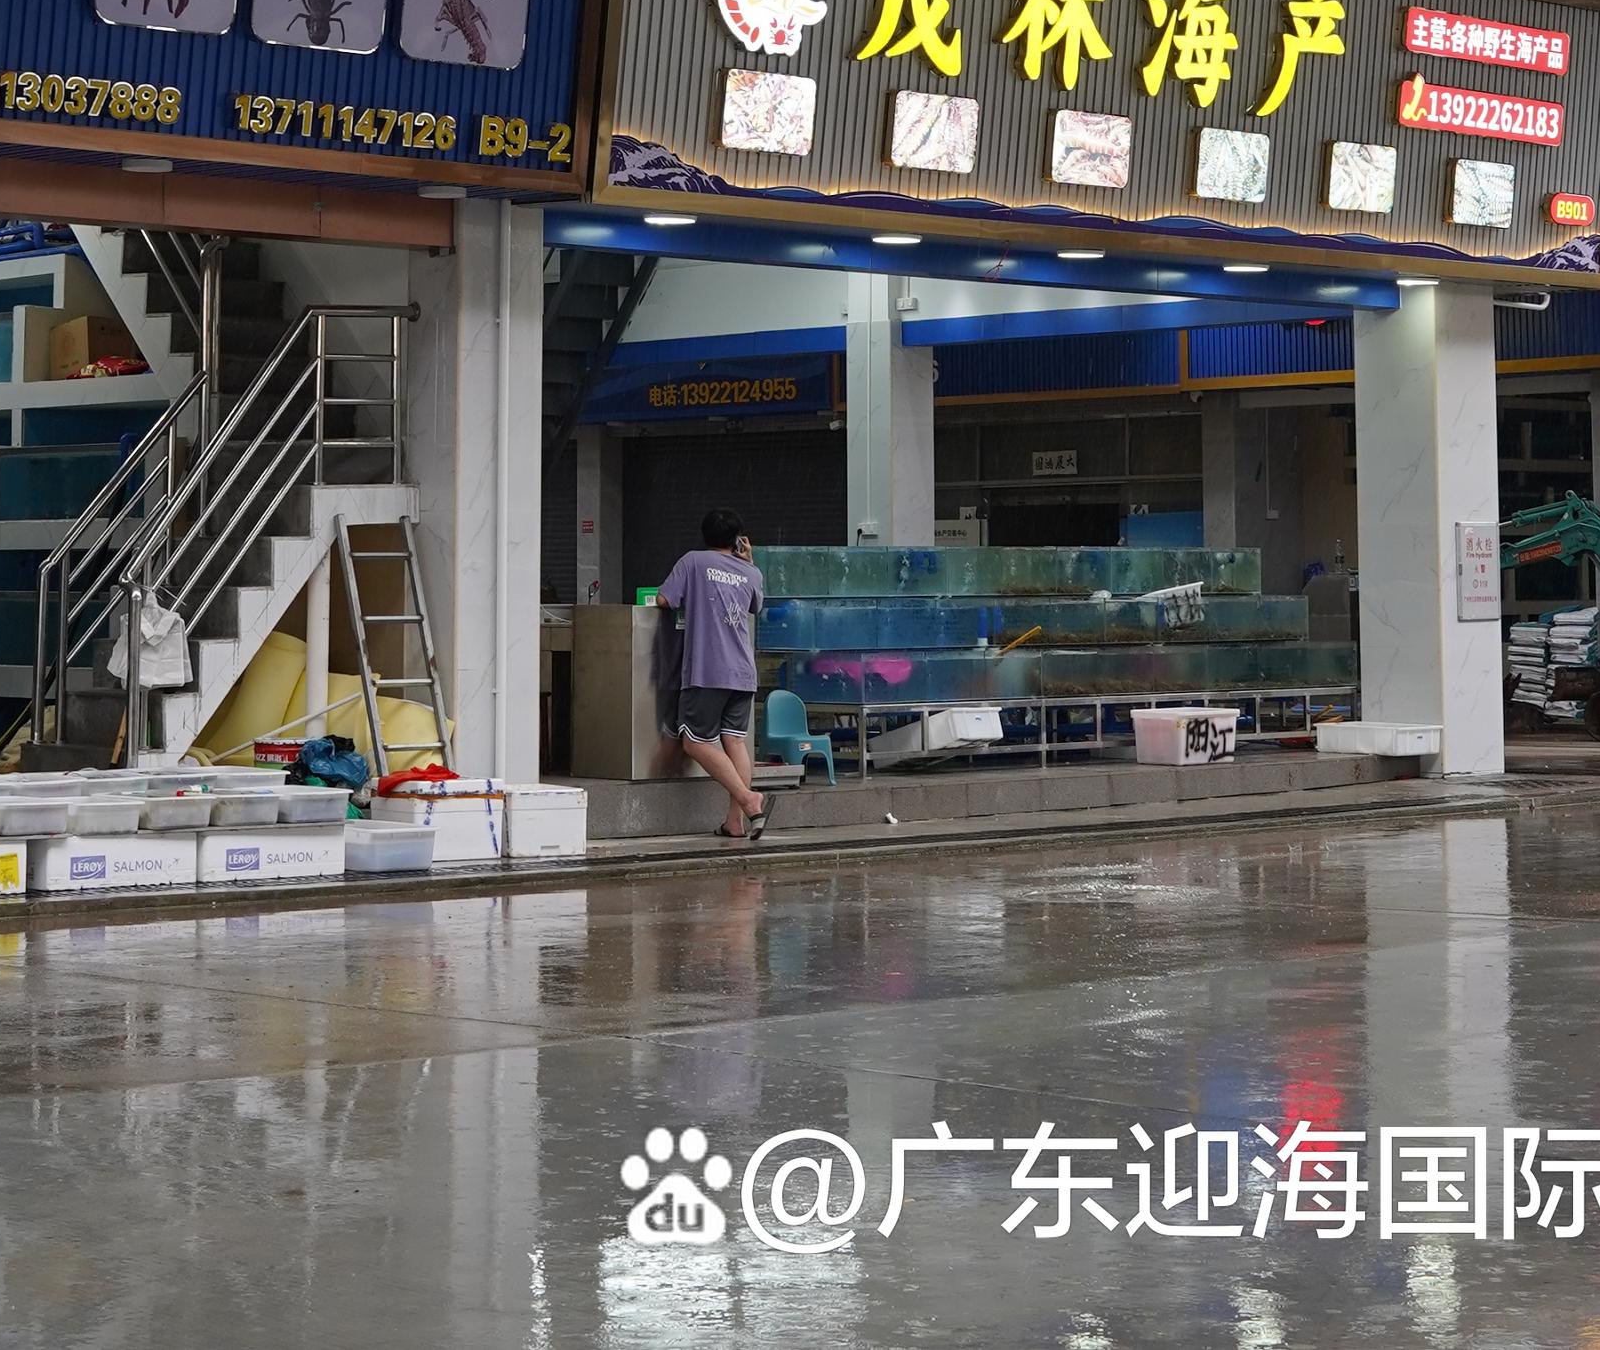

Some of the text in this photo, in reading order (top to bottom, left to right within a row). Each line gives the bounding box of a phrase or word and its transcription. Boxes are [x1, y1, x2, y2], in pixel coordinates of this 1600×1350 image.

[1426, 90, 1560, 139] 13922262183
[233, 93, 457, 153] 13711147126
[479, 115, 573, 164] B9-2
[1556, 200, 1588, 221] B901
[706, 567, 749, 584] CONSCIOUS
[707, 574, 741, 587] THERAPY
[113, 859, 163, 873] SALMON
[266, 852, 313, 865] SALMON
